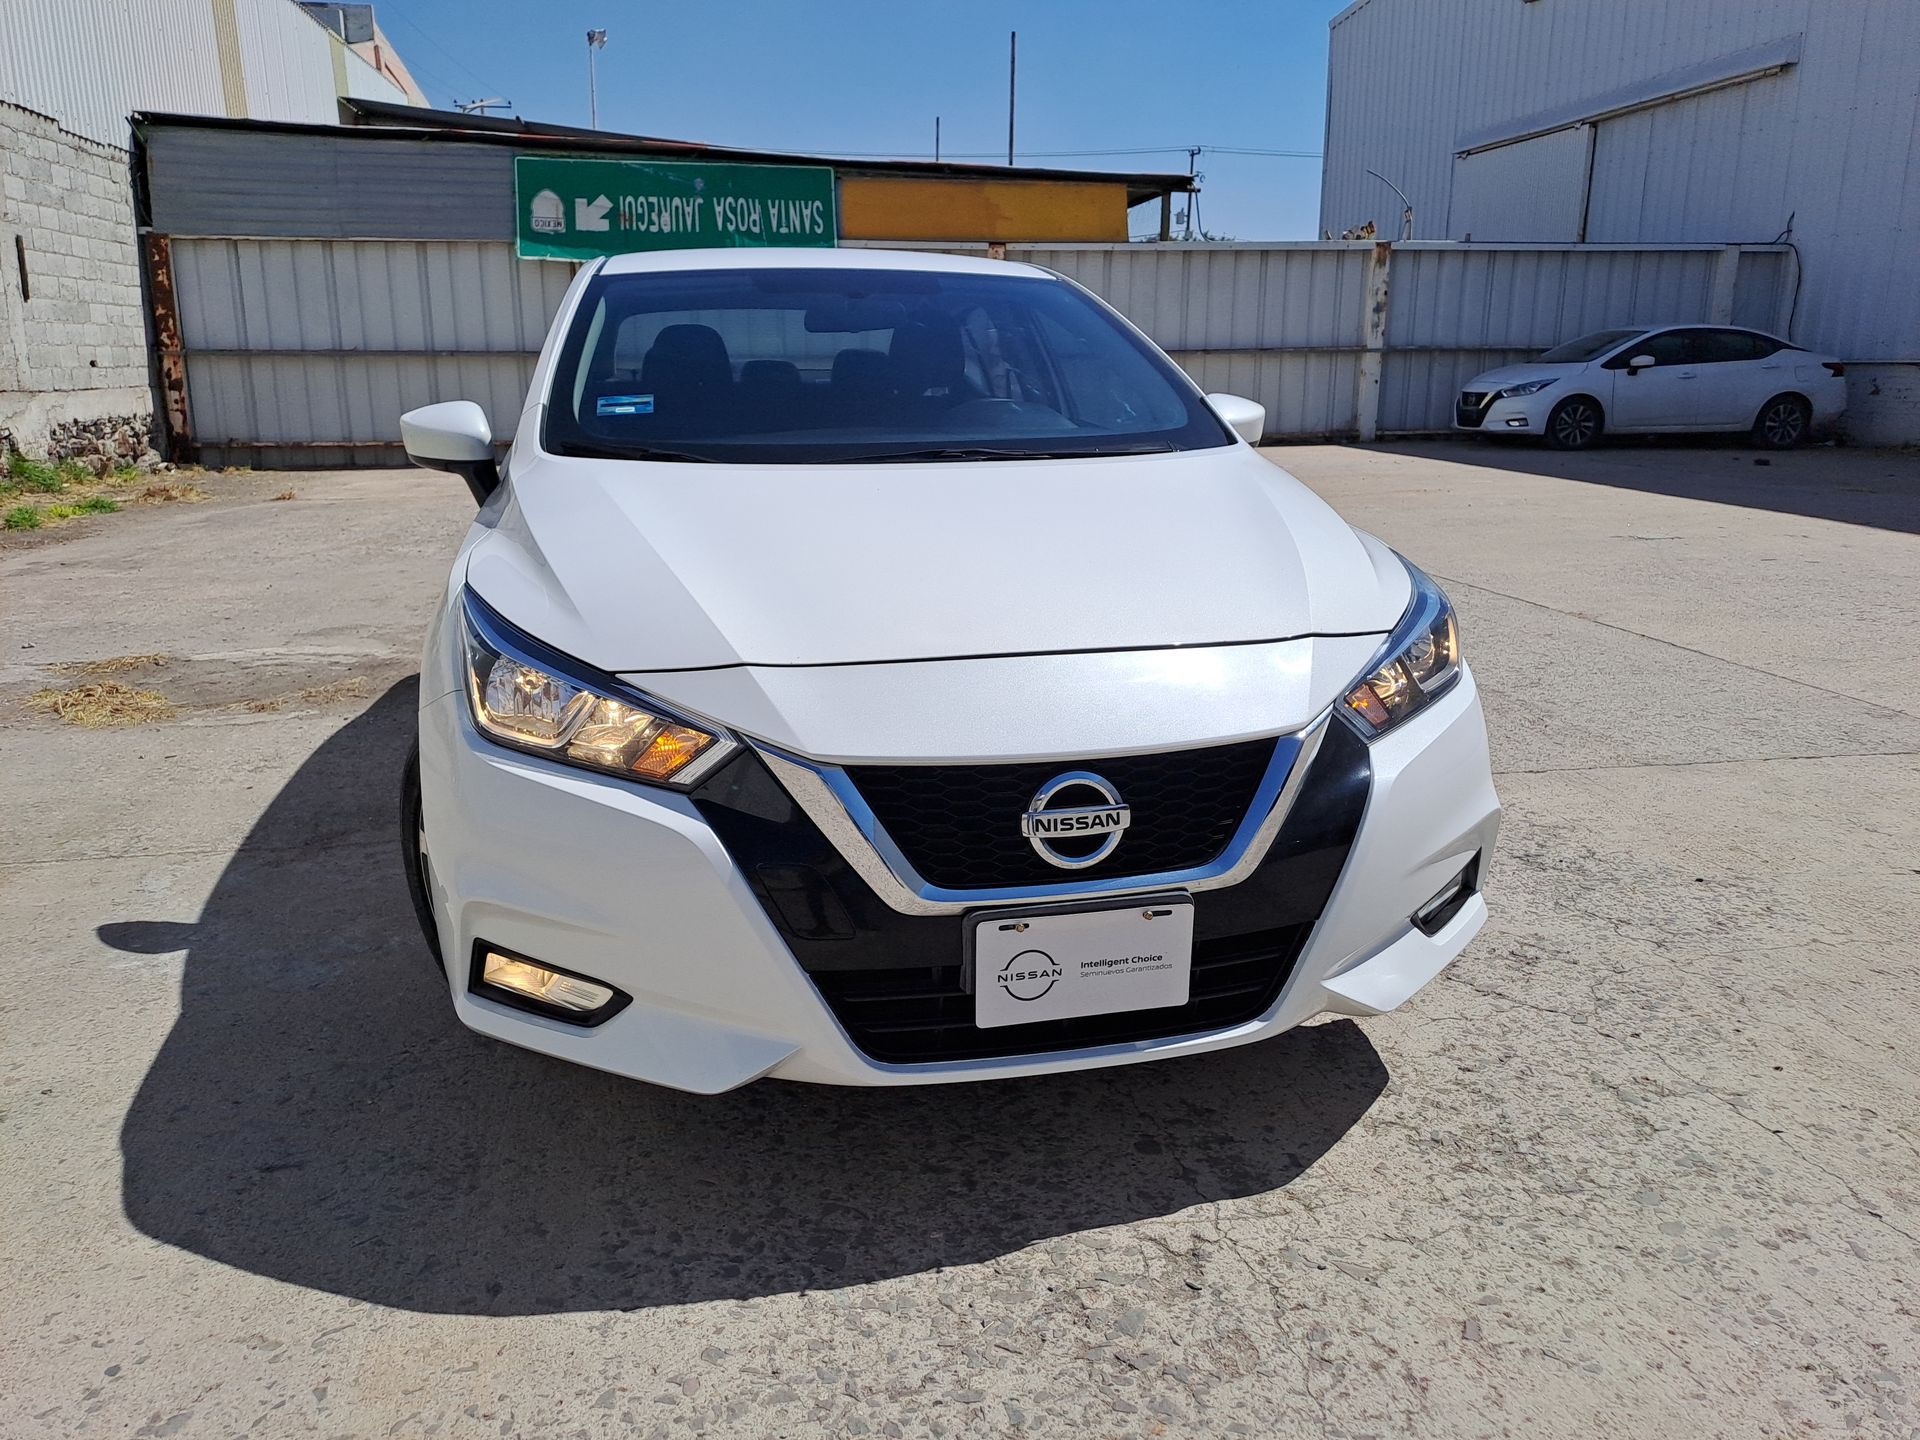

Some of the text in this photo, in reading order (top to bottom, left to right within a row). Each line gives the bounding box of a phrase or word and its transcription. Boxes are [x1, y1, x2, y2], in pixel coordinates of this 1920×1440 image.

[619, 195, 824, 234] SANTA ROSA JAUREGUI
[534, 219, 563, 228] MEXICO
[1035, 811, 1121, 833] NISSAN
[1080, 954, 1163, 969] Intelligent Choice
[997, 968, 1063, 984] NISSAN
[1080, 963, 1173, 978] Seminuevos Garantizados
